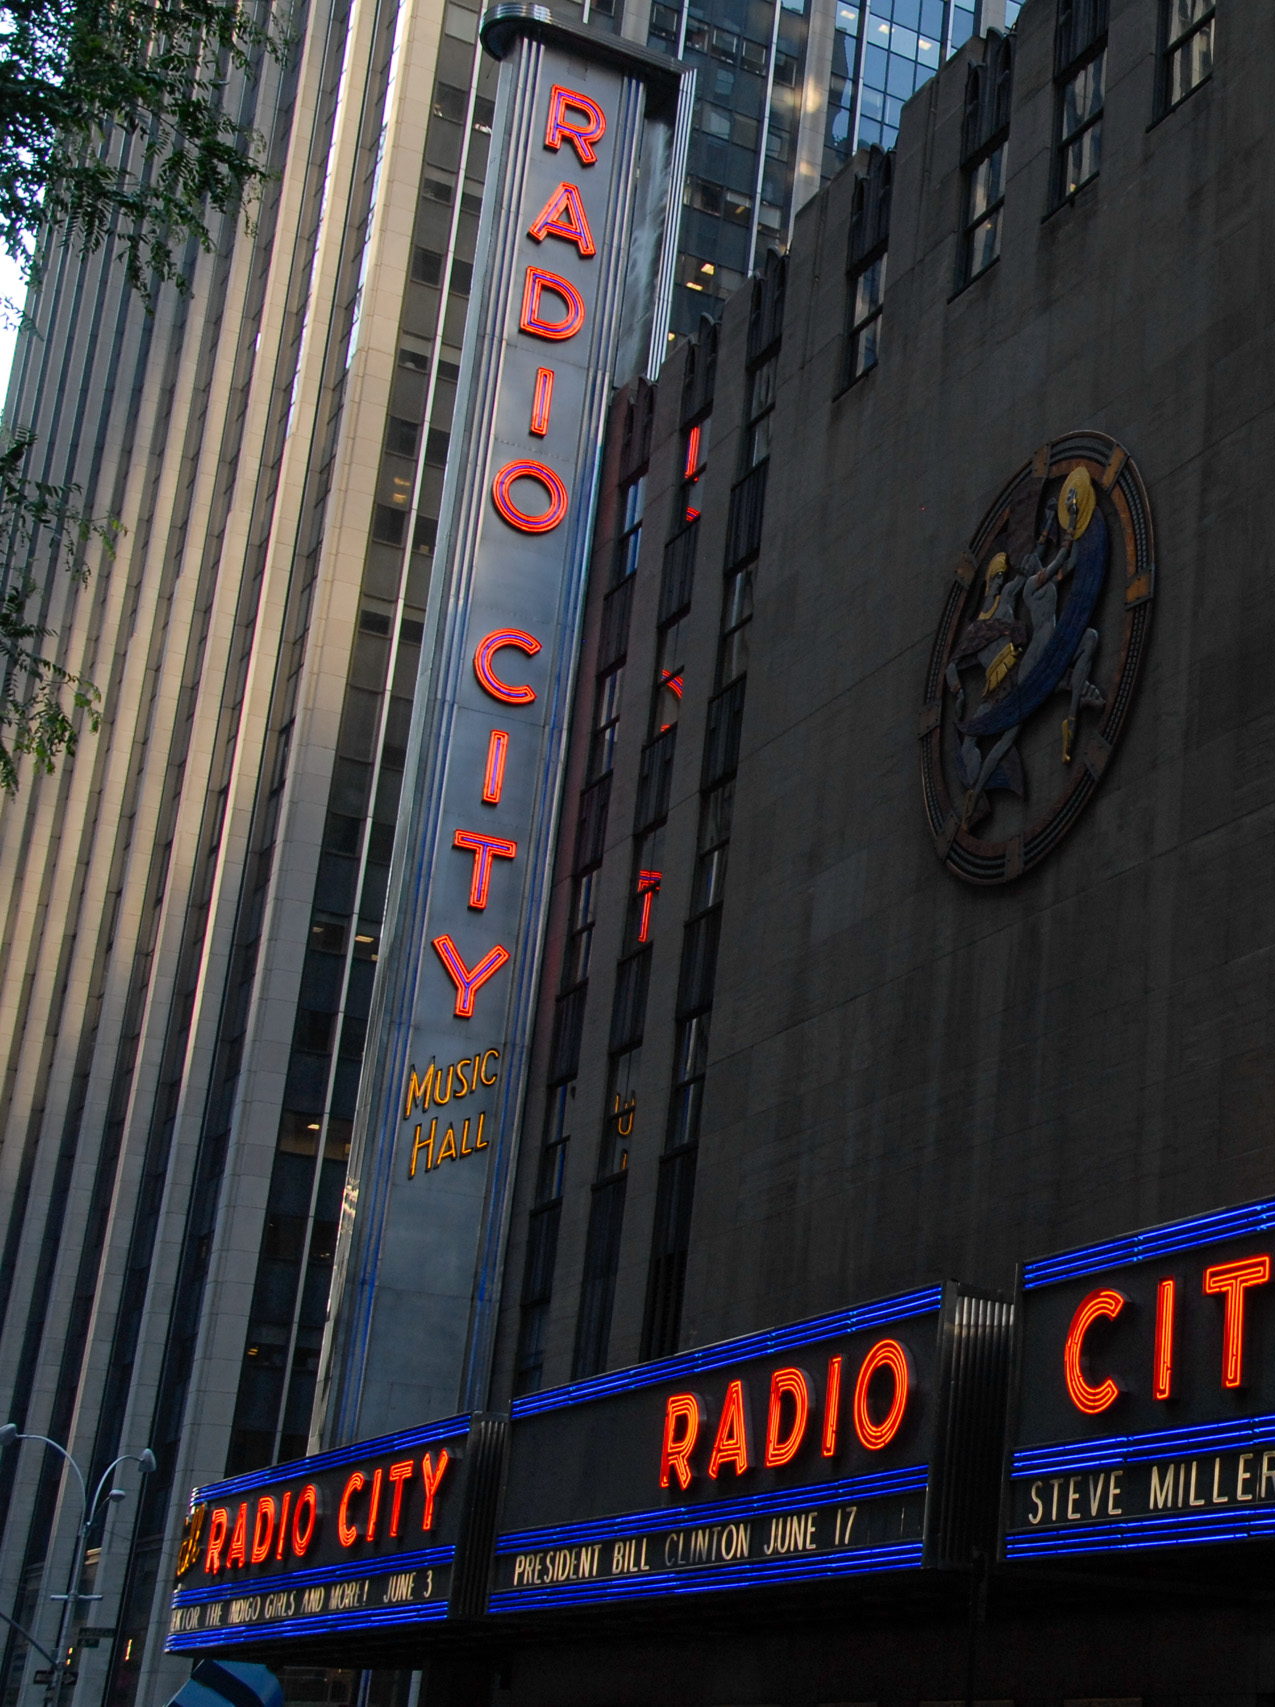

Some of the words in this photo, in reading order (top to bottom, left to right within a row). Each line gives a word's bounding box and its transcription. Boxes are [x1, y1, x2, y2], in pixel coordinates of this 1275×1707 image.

[493, 83, 606, 536] RADIO
[432, 627, 543, 1019] CITY
[404, 1047, 501, 1120] MUSIC
[408, 1111, 489, 1179] HALL
[658, 1337, 910, 1491] RADIO
[204, 1483, 317, 1576] RADIO
[337, 1448, 450, 1549] CITY
[1027, 1470, 1124, 1526] STEVE
[512, 1543, 603, 1587] PRESIDENT
[611, 1537, 651, 1576] BILL
[664, 1522, 750, 1567] CLINTON
[763, 1511, 819, 1556] JUNE
[834, 1505, 858, 1546] 17
[205, 1601, 224, 1627] THE
[264, 1590, 297, 1620] GIRLS
[300, 1585, 325, 1614] AND
[383, 1571, 417, 1604] JUNE
[423, 1569, 433, 1599] 3
